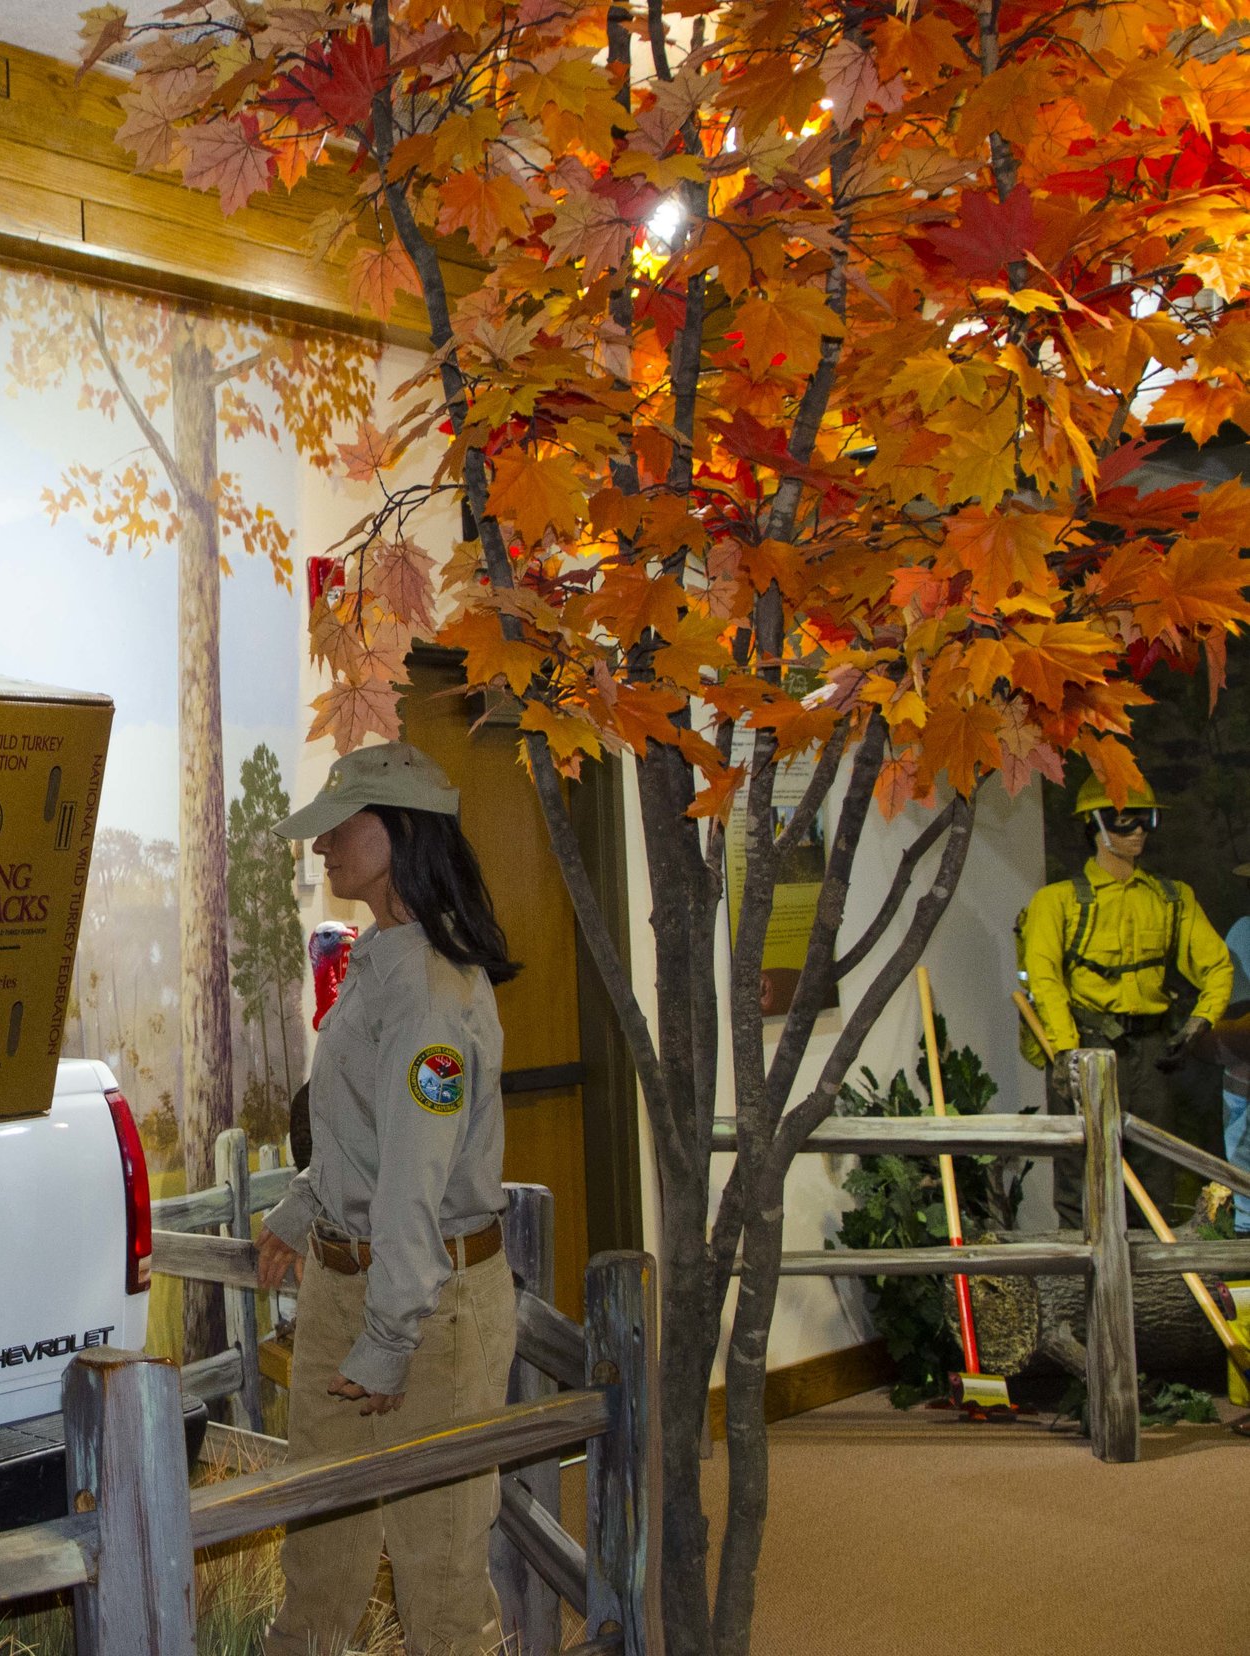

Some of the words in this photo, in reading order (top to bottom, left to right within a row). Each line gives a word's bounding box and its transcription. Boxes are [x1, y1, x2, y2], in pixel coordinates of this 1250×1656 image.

[21, 735, 64, 751] TURKEY
[79, 754, 103, 841] NATIONAL
[73, 845, 88, 887] WILD
[63, 891, 82, 951] TURKEY
[48, 956, 72, 1056] FEDERATION
